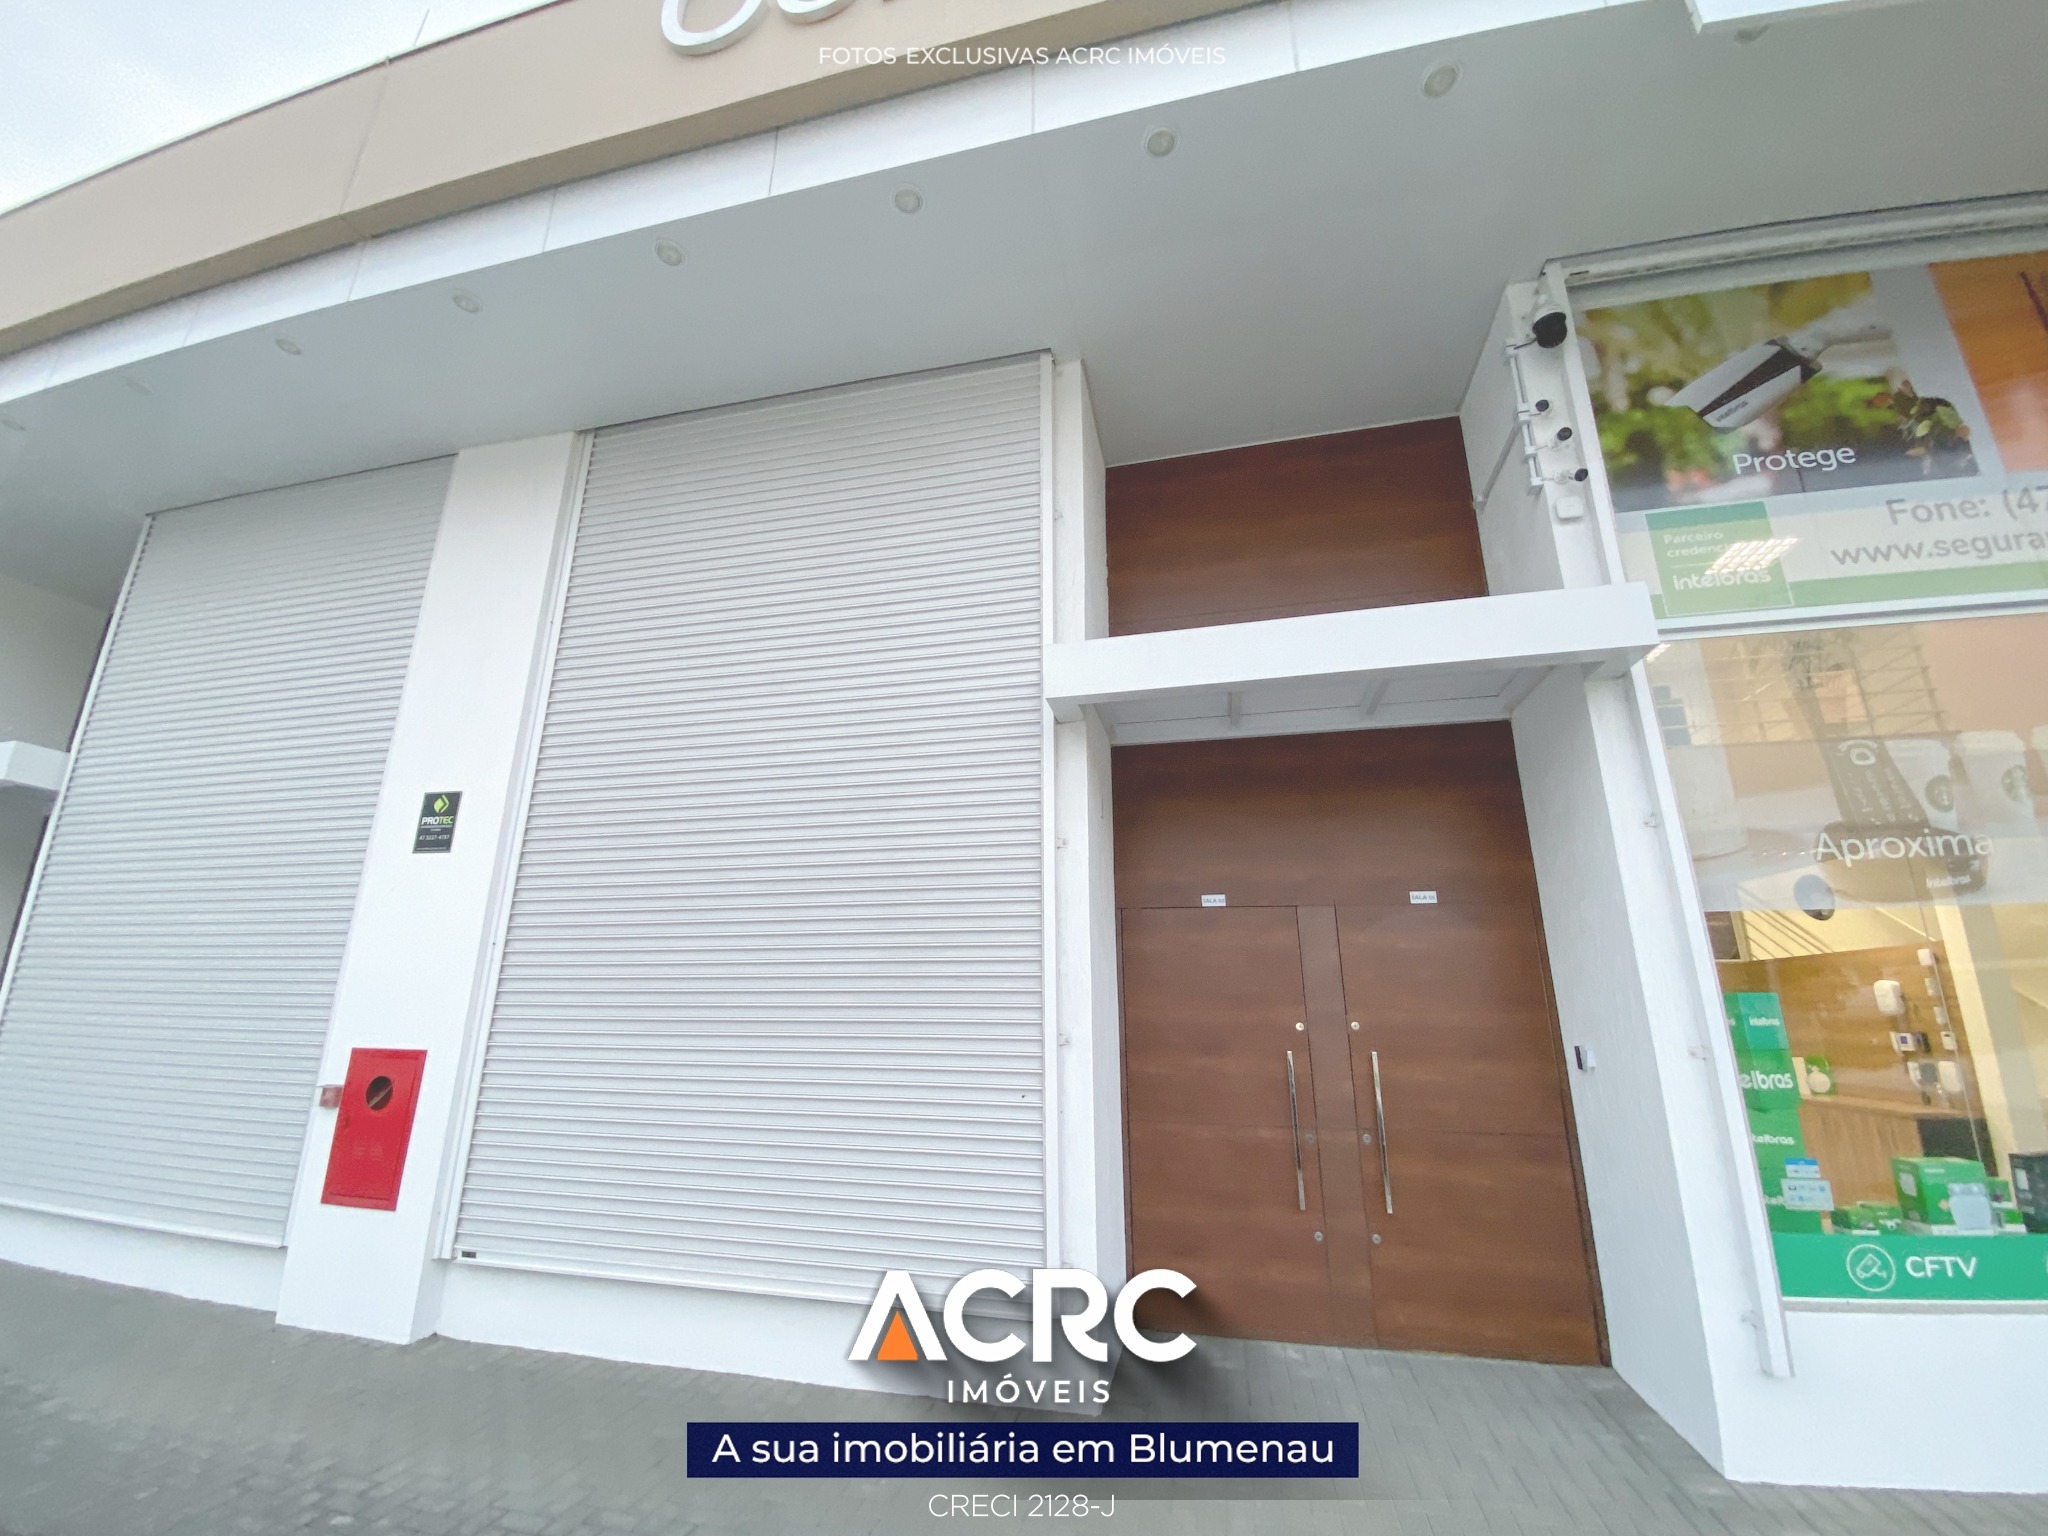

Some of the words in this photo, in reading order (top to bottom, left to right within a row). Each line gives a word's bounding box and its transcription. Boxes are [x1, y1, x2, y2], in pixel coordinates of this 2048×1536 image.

[1732, 447, 1857, 475] Protege
[1886, 498, 1991, 525] Fone:
[1663, 530, 1724, 545] Parceiro
[1831, 531, 2048, 566] www.segura
[1667, 544, 1729, 558] credenc
[421, 816, 454, 825] PROTEC
[1816, 828, 1994, 868] Aproxima
[1905, 1256, 1978, 1279] CFTV
